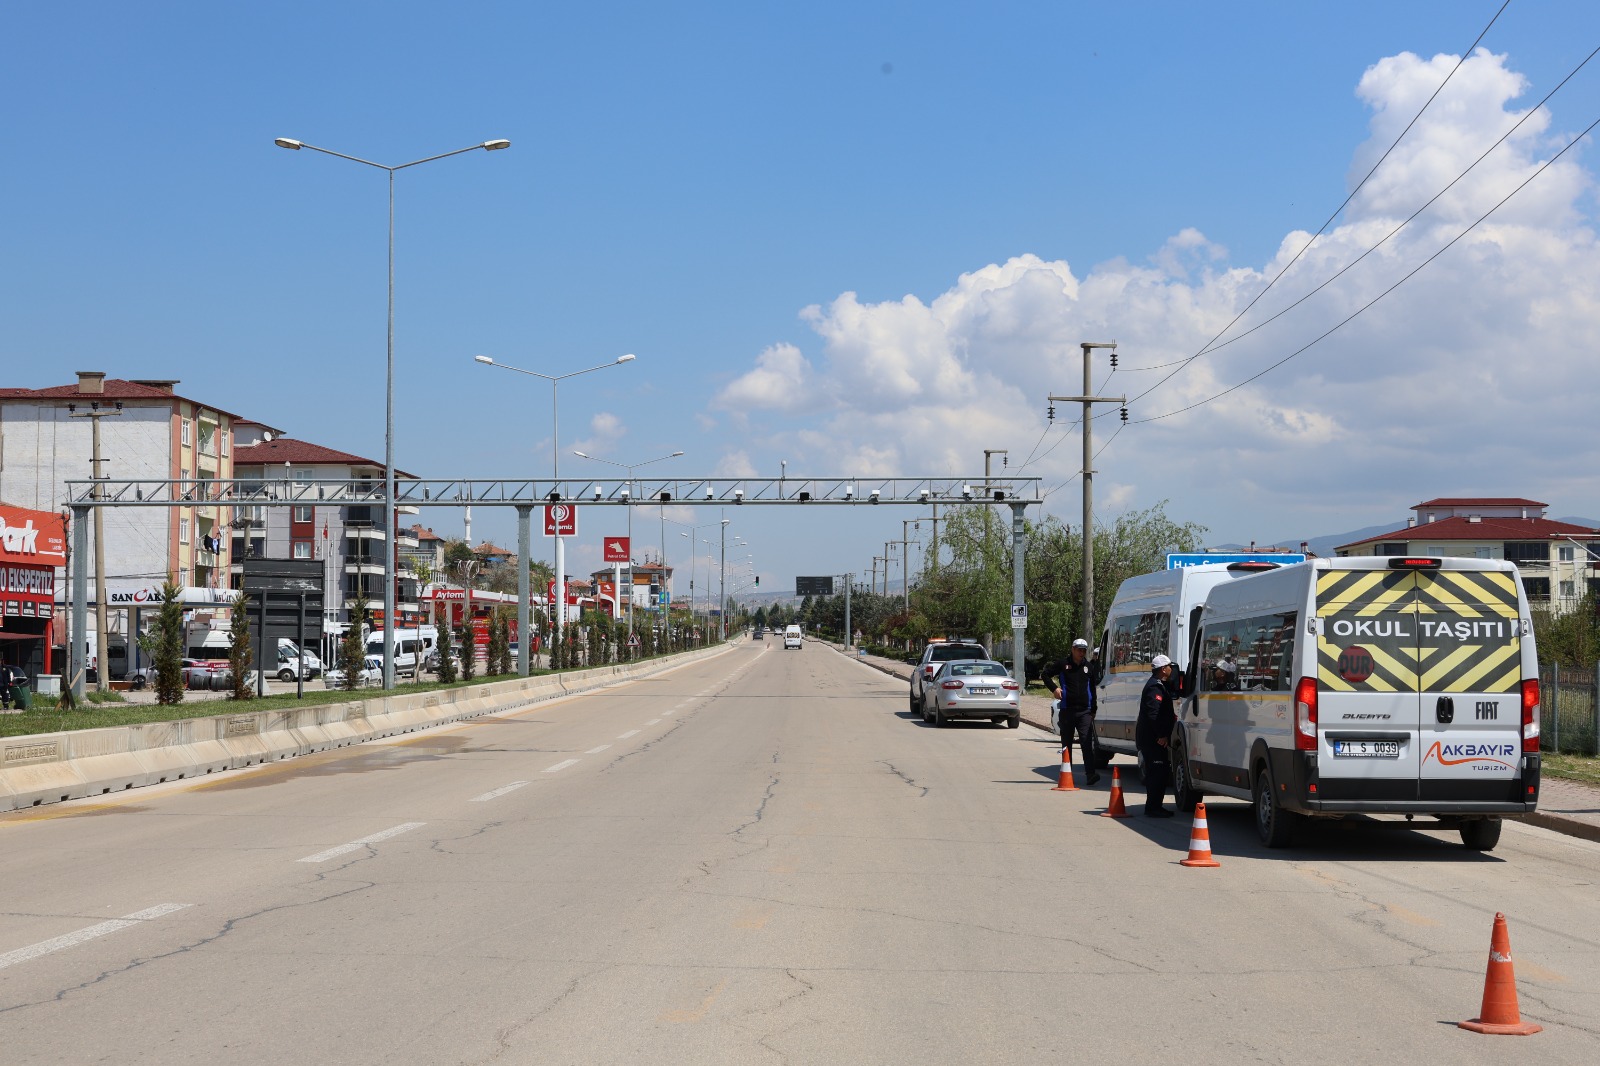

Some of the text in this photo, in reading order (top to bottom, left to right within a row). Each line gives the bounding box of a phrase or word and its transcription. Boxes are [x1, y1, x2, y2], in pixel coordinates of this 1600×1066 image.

[436, 591, 465, 600] Aytemi
[1333, 620, 1503, 641] OKUL TAŞITI
[1339, 655, 1371, 675] DUR
[1475, 702, 1499, 720] FIAT
[1340, 742, 1397, 753] 71 S 0039
[1442, 744, 1514, 756] AKBAYIR
